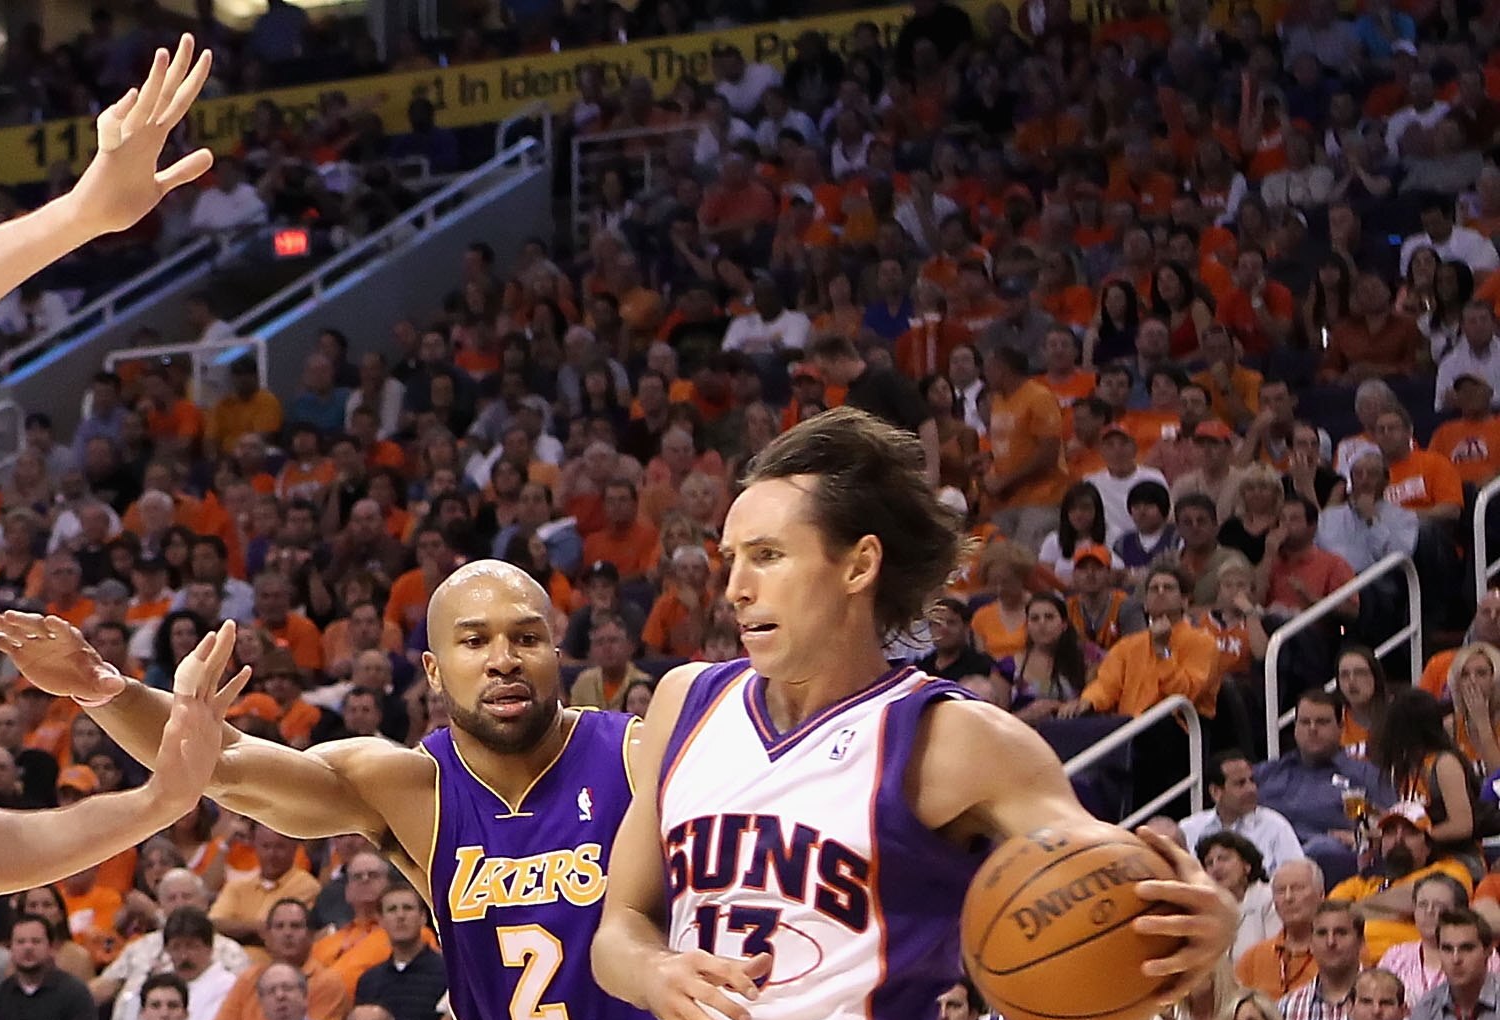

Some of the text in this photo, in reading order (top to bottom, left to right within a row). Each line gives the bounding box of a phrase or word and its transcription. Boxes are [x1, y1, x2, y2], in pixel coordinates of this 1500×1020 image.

[449, 843, 608, 922] LAKERS
[663, 812, 873, 935] SUNS
[696, 904, 782, 992] 13
